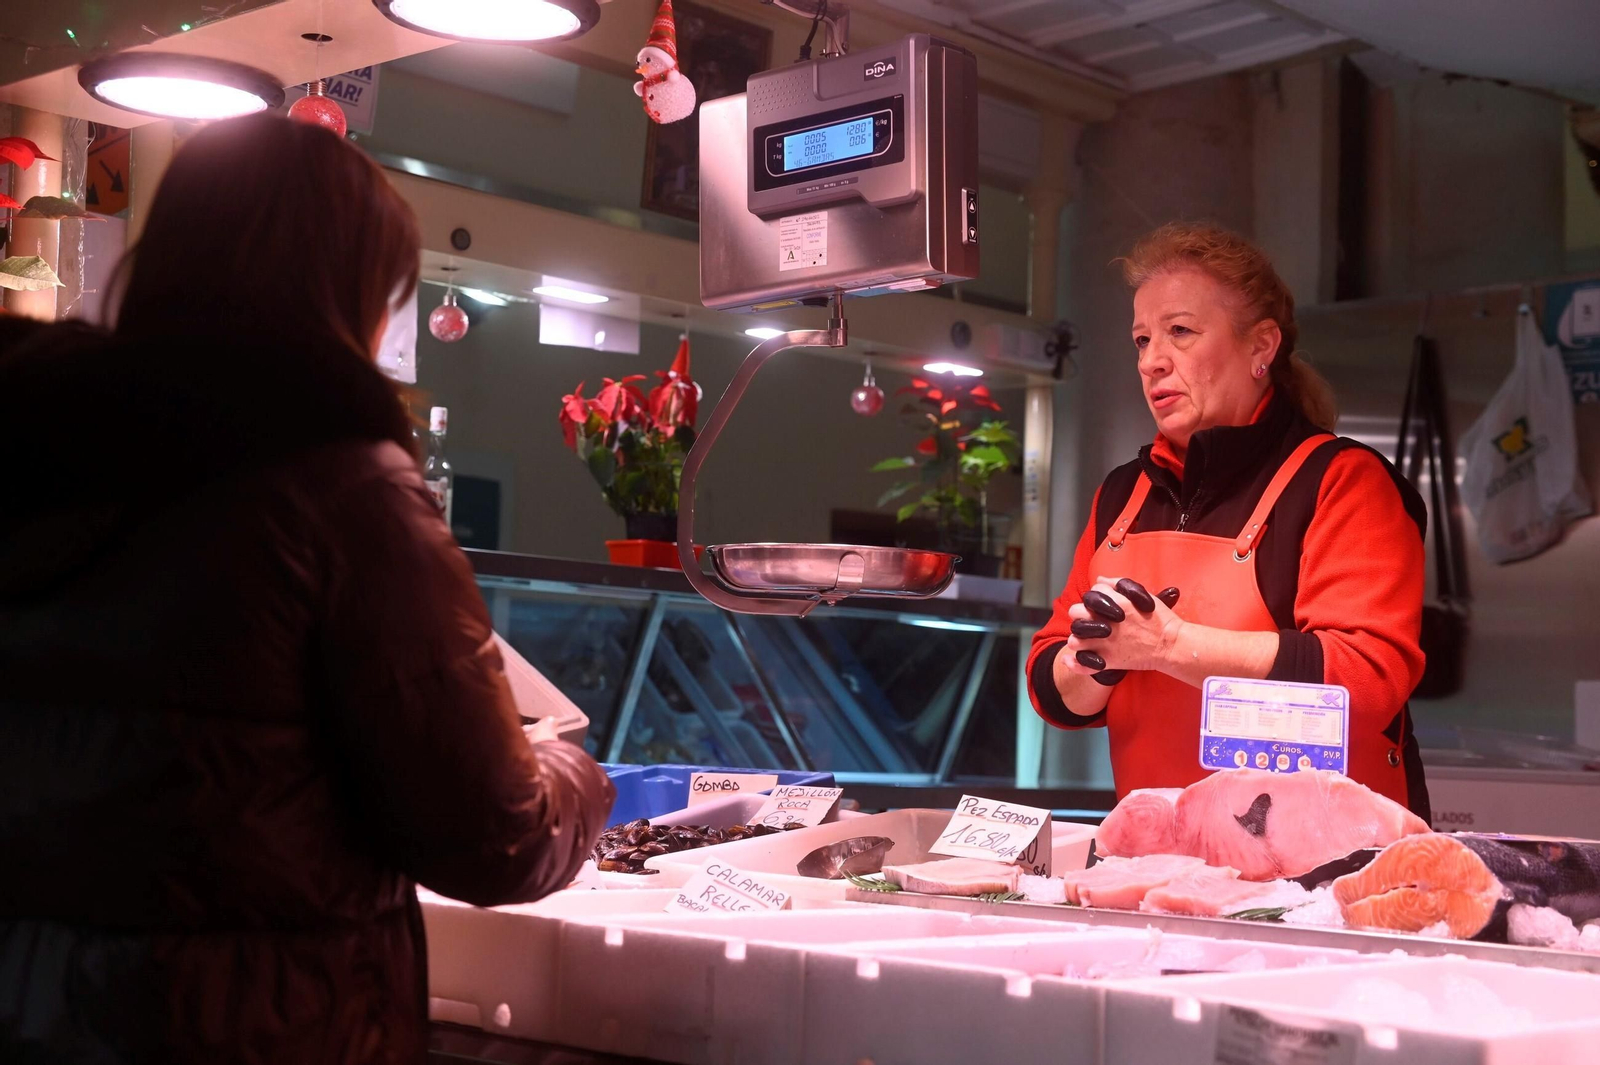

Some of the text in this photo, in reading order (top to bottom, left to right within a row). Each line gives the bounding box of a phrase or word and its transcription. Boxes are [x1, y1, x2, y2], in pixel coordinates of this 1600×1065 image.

[865, 63, 895, 76] DINA
[804, 122, 867, 146] 0005 1280
[849, 133, 867, 147] 006
[804, 143, 827, 157] 0000
[1323, 750, 1341, 760] P.V.P.
[778, 797, 811, 809] ROCA
[706, 864, 785, 906] CALAMAR
